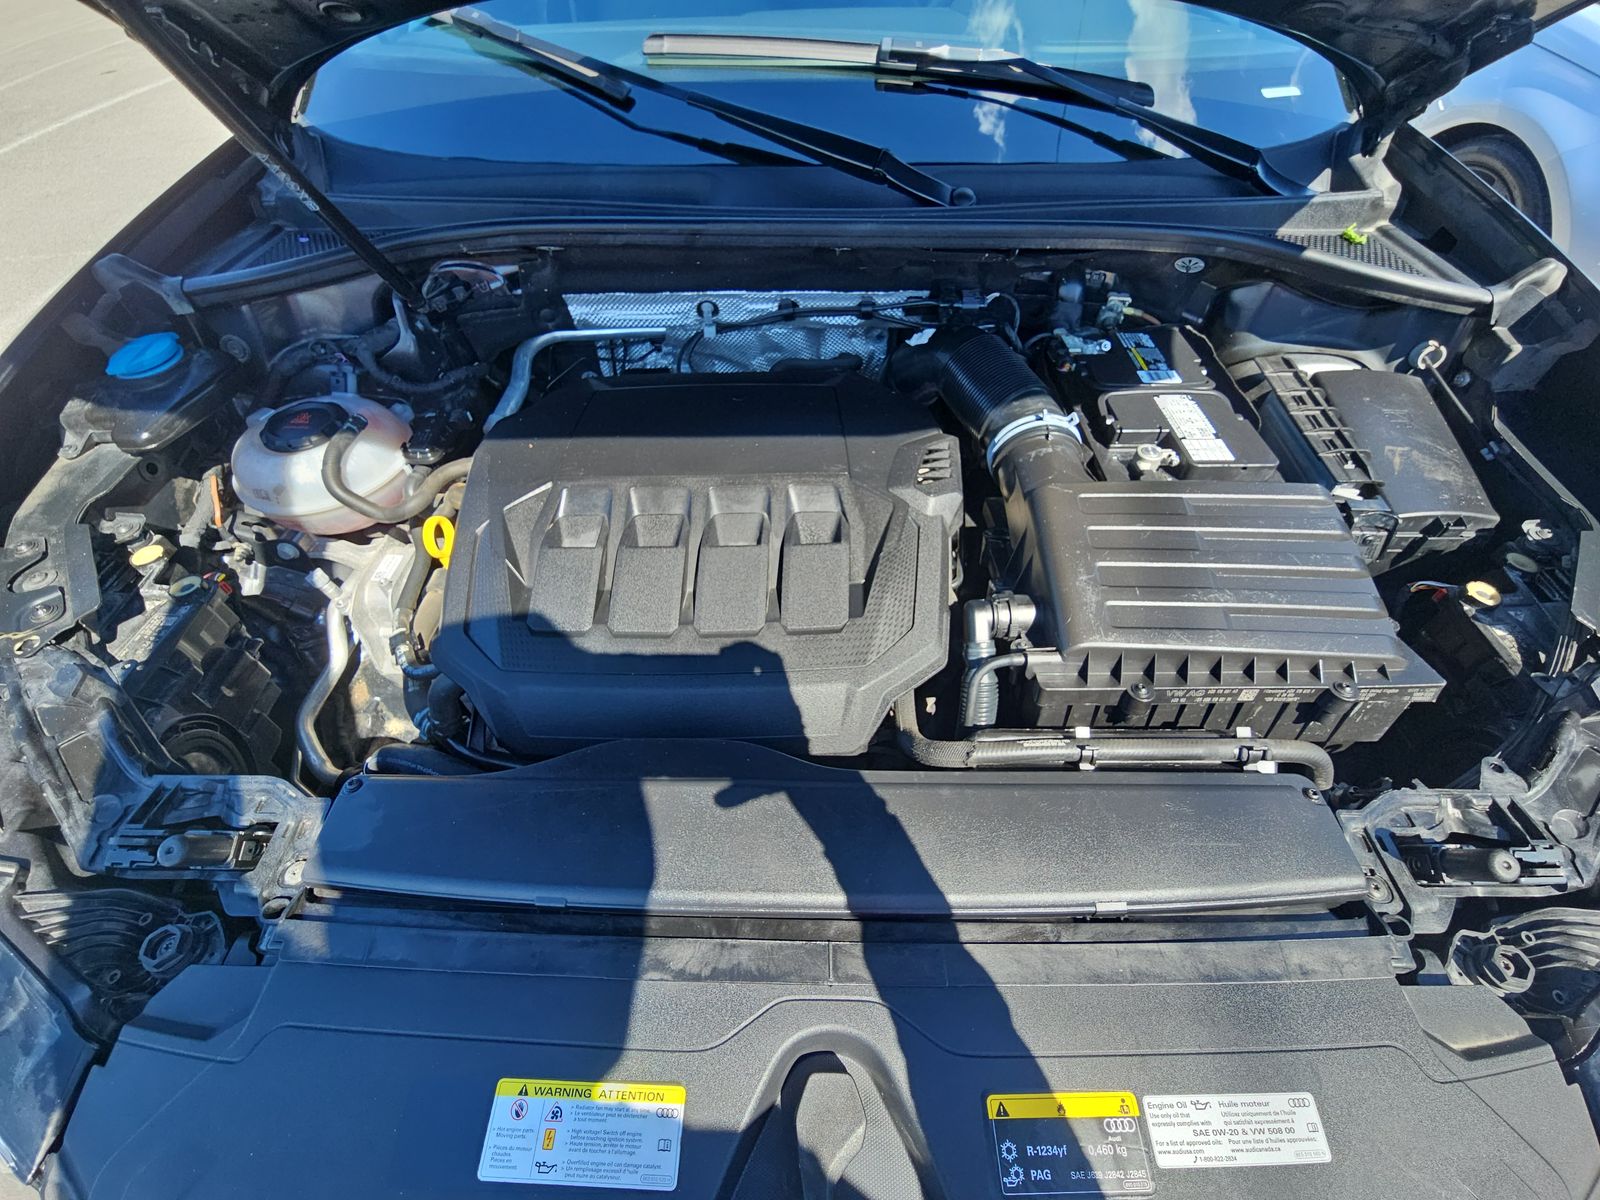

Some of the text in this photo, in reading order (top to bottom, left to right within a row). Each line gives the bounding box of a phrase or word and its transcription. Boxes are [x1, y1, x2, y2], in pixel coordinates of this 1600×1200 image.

[534, 1086, 665, 1102] WARNING ATTENTION
[1147, 1101, 1187, 1110] Engine Oil
[1193, 1129, 1210, 1137] SAE
[1026, 1145, 1067, 1158] R-1234yf
[1088, 1145, 1128, 1157] 0,460 kg
[1030, 1169, 1052, 1181] PAG
[1070, 1171, 1086, 1180] SAE
[1104, 1170, 1125, 1179] J2842
[1126, 1169, 1147, 1178] J2845
